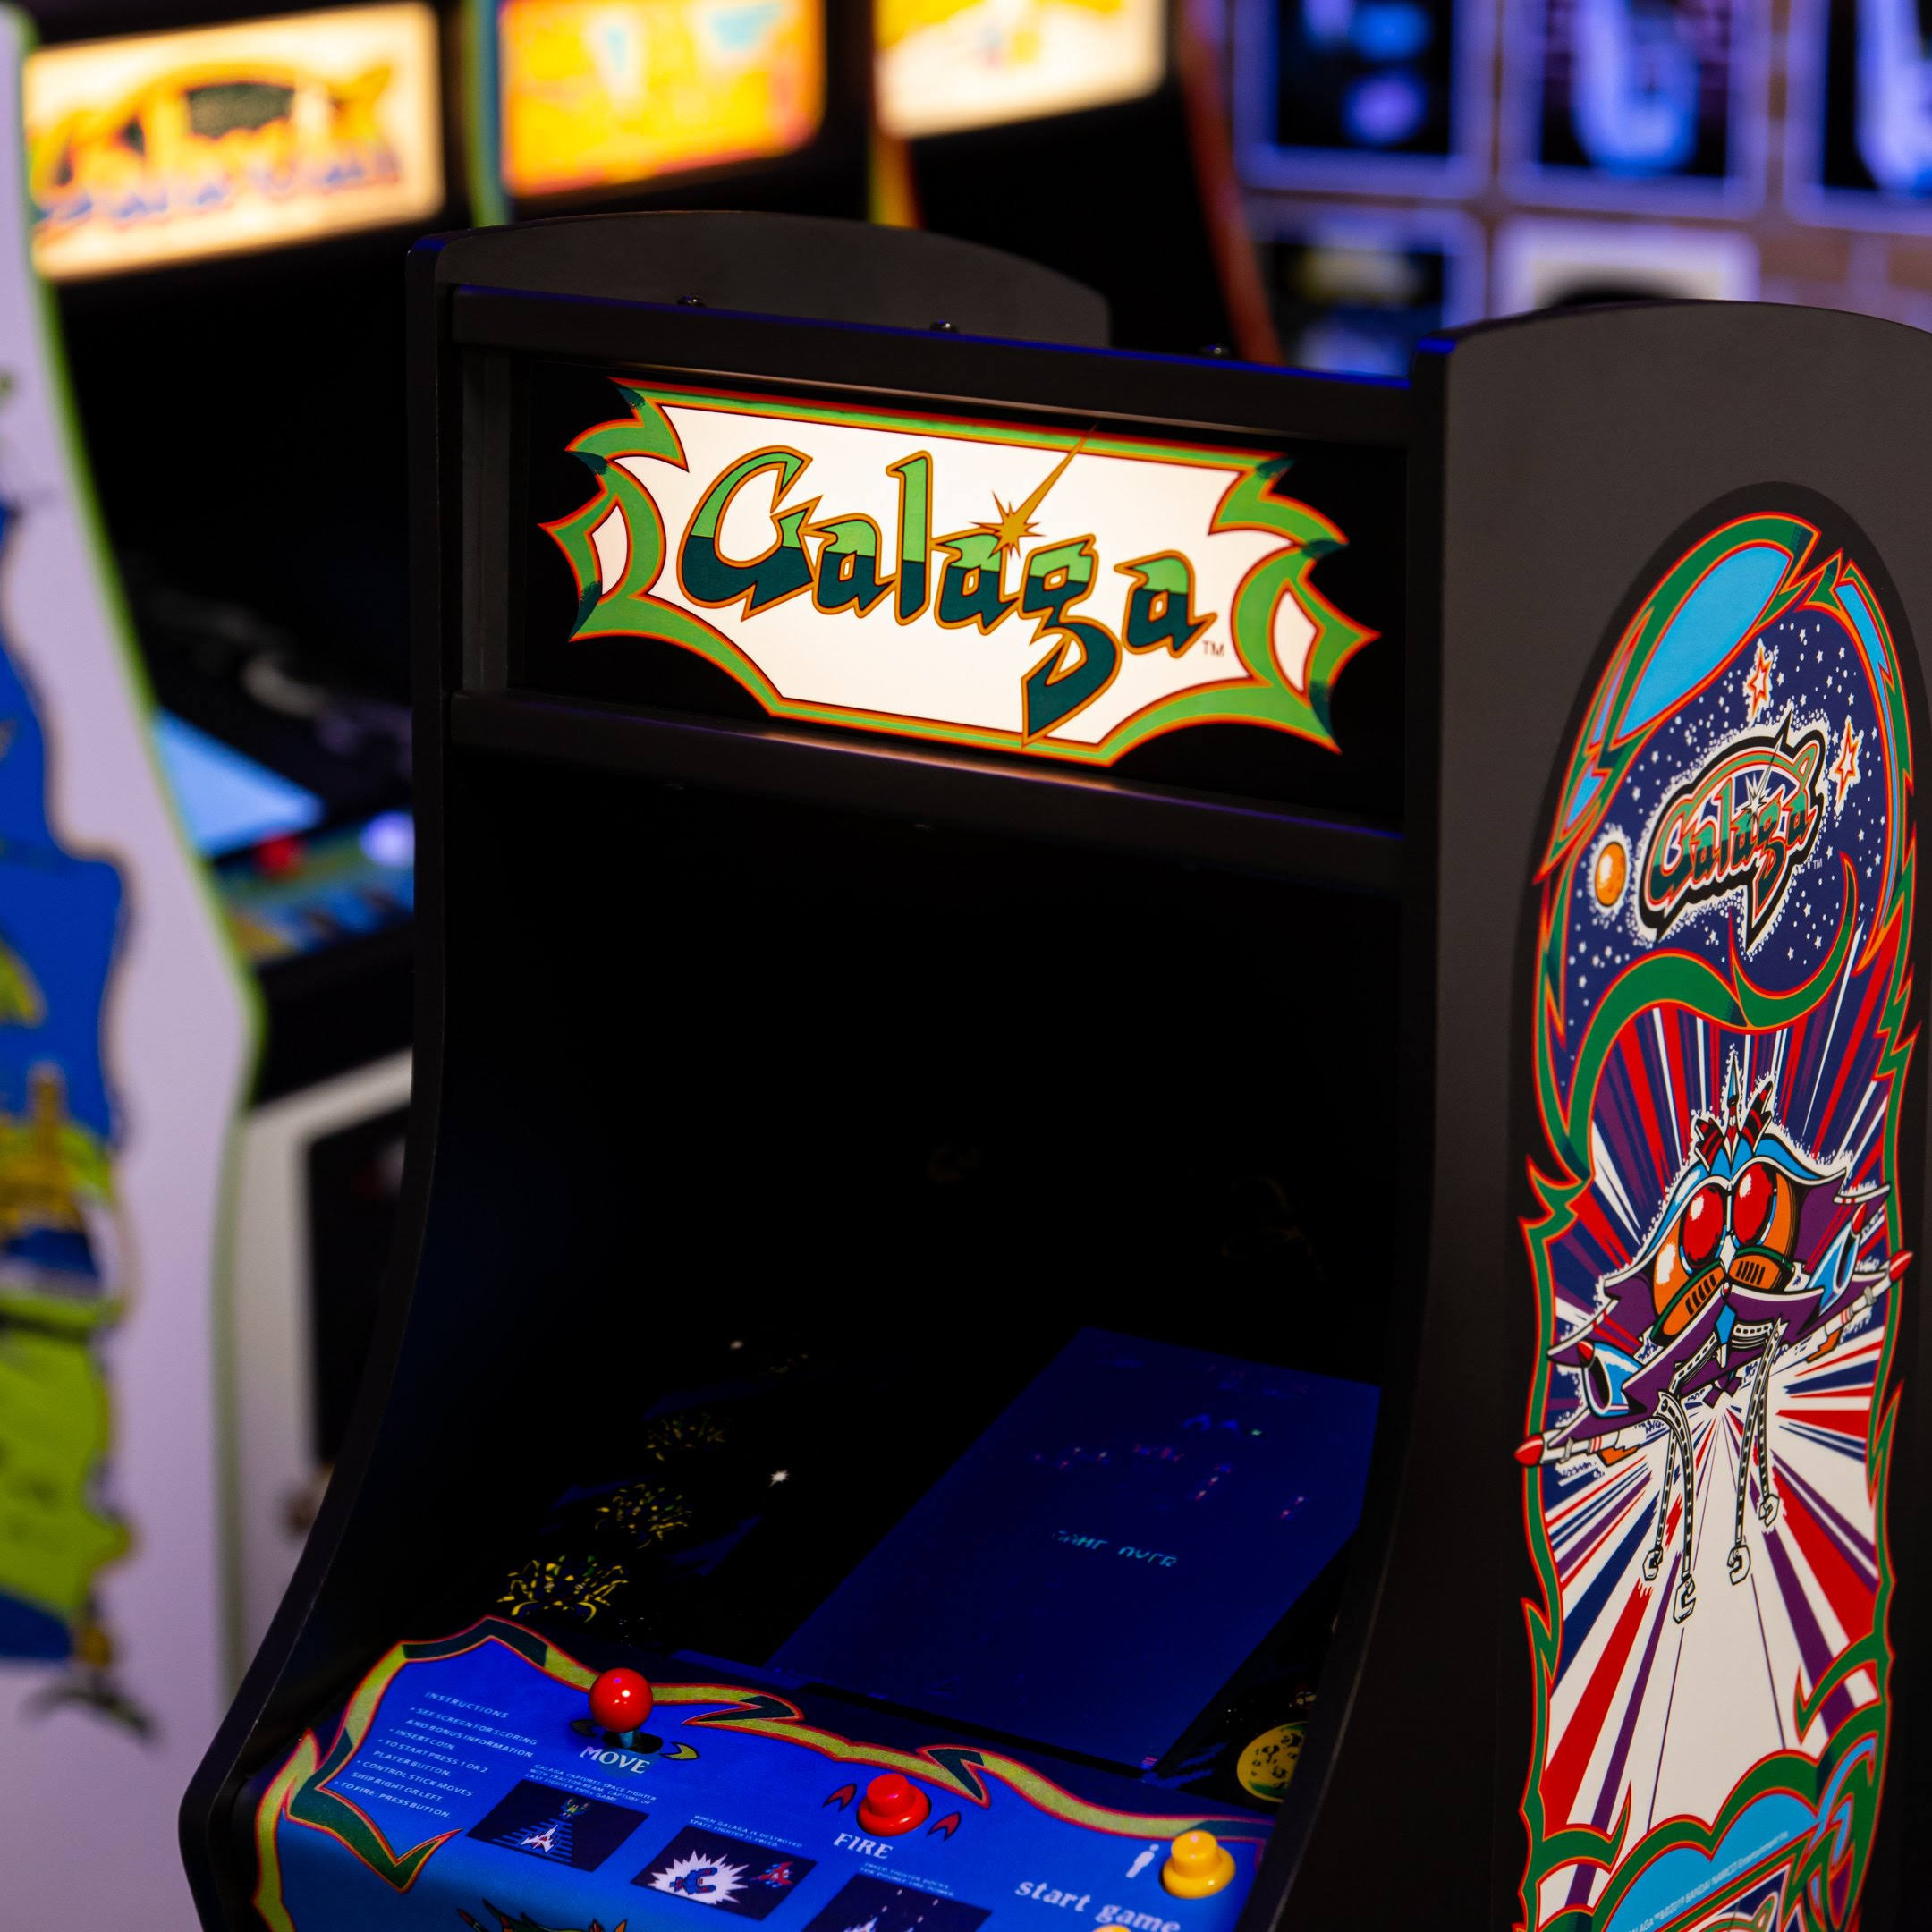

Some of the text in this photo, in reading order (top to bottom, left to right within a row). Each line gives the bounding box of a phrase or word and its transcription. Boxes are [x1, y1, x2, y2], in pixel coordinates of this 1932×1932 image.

[677, 444, 1217, 746] Galaga
[425, 1691, 508, 1718] INSTRUCTIONS
[395, 1730, 429, 1742] INSERT
[405, 1719, 428, 1729] AND
[428, 1724, 462, 1739] BONUS
[416, 1708, 538, 1745] SEE SCREEN FOR SCORING
[373, 1750, 411, 1765] PLAYER
[386, 1740, 399, 1748] TO
[398, 1743, 429, 1756] START
[428, 1752, 459, 1765] PRESS
[466, 1763, 481, 1771] OR
[580, 1746, 651, 1774] MOVE
[352, 1772, 375, 1782] SHIP
[373, 1778, 405, 1791] RIGHT
[404, 1787, 419, 1795] OR
[362, 1761, 475, 1797] CONTROL STICK MOVES
[341, 1782, 354, 1790] TO
[378, 1793, 411, 1806] PRESS
[833, 1832, 894, 1859] FIRE
[1014, 1881, 1181, 1932] start game
